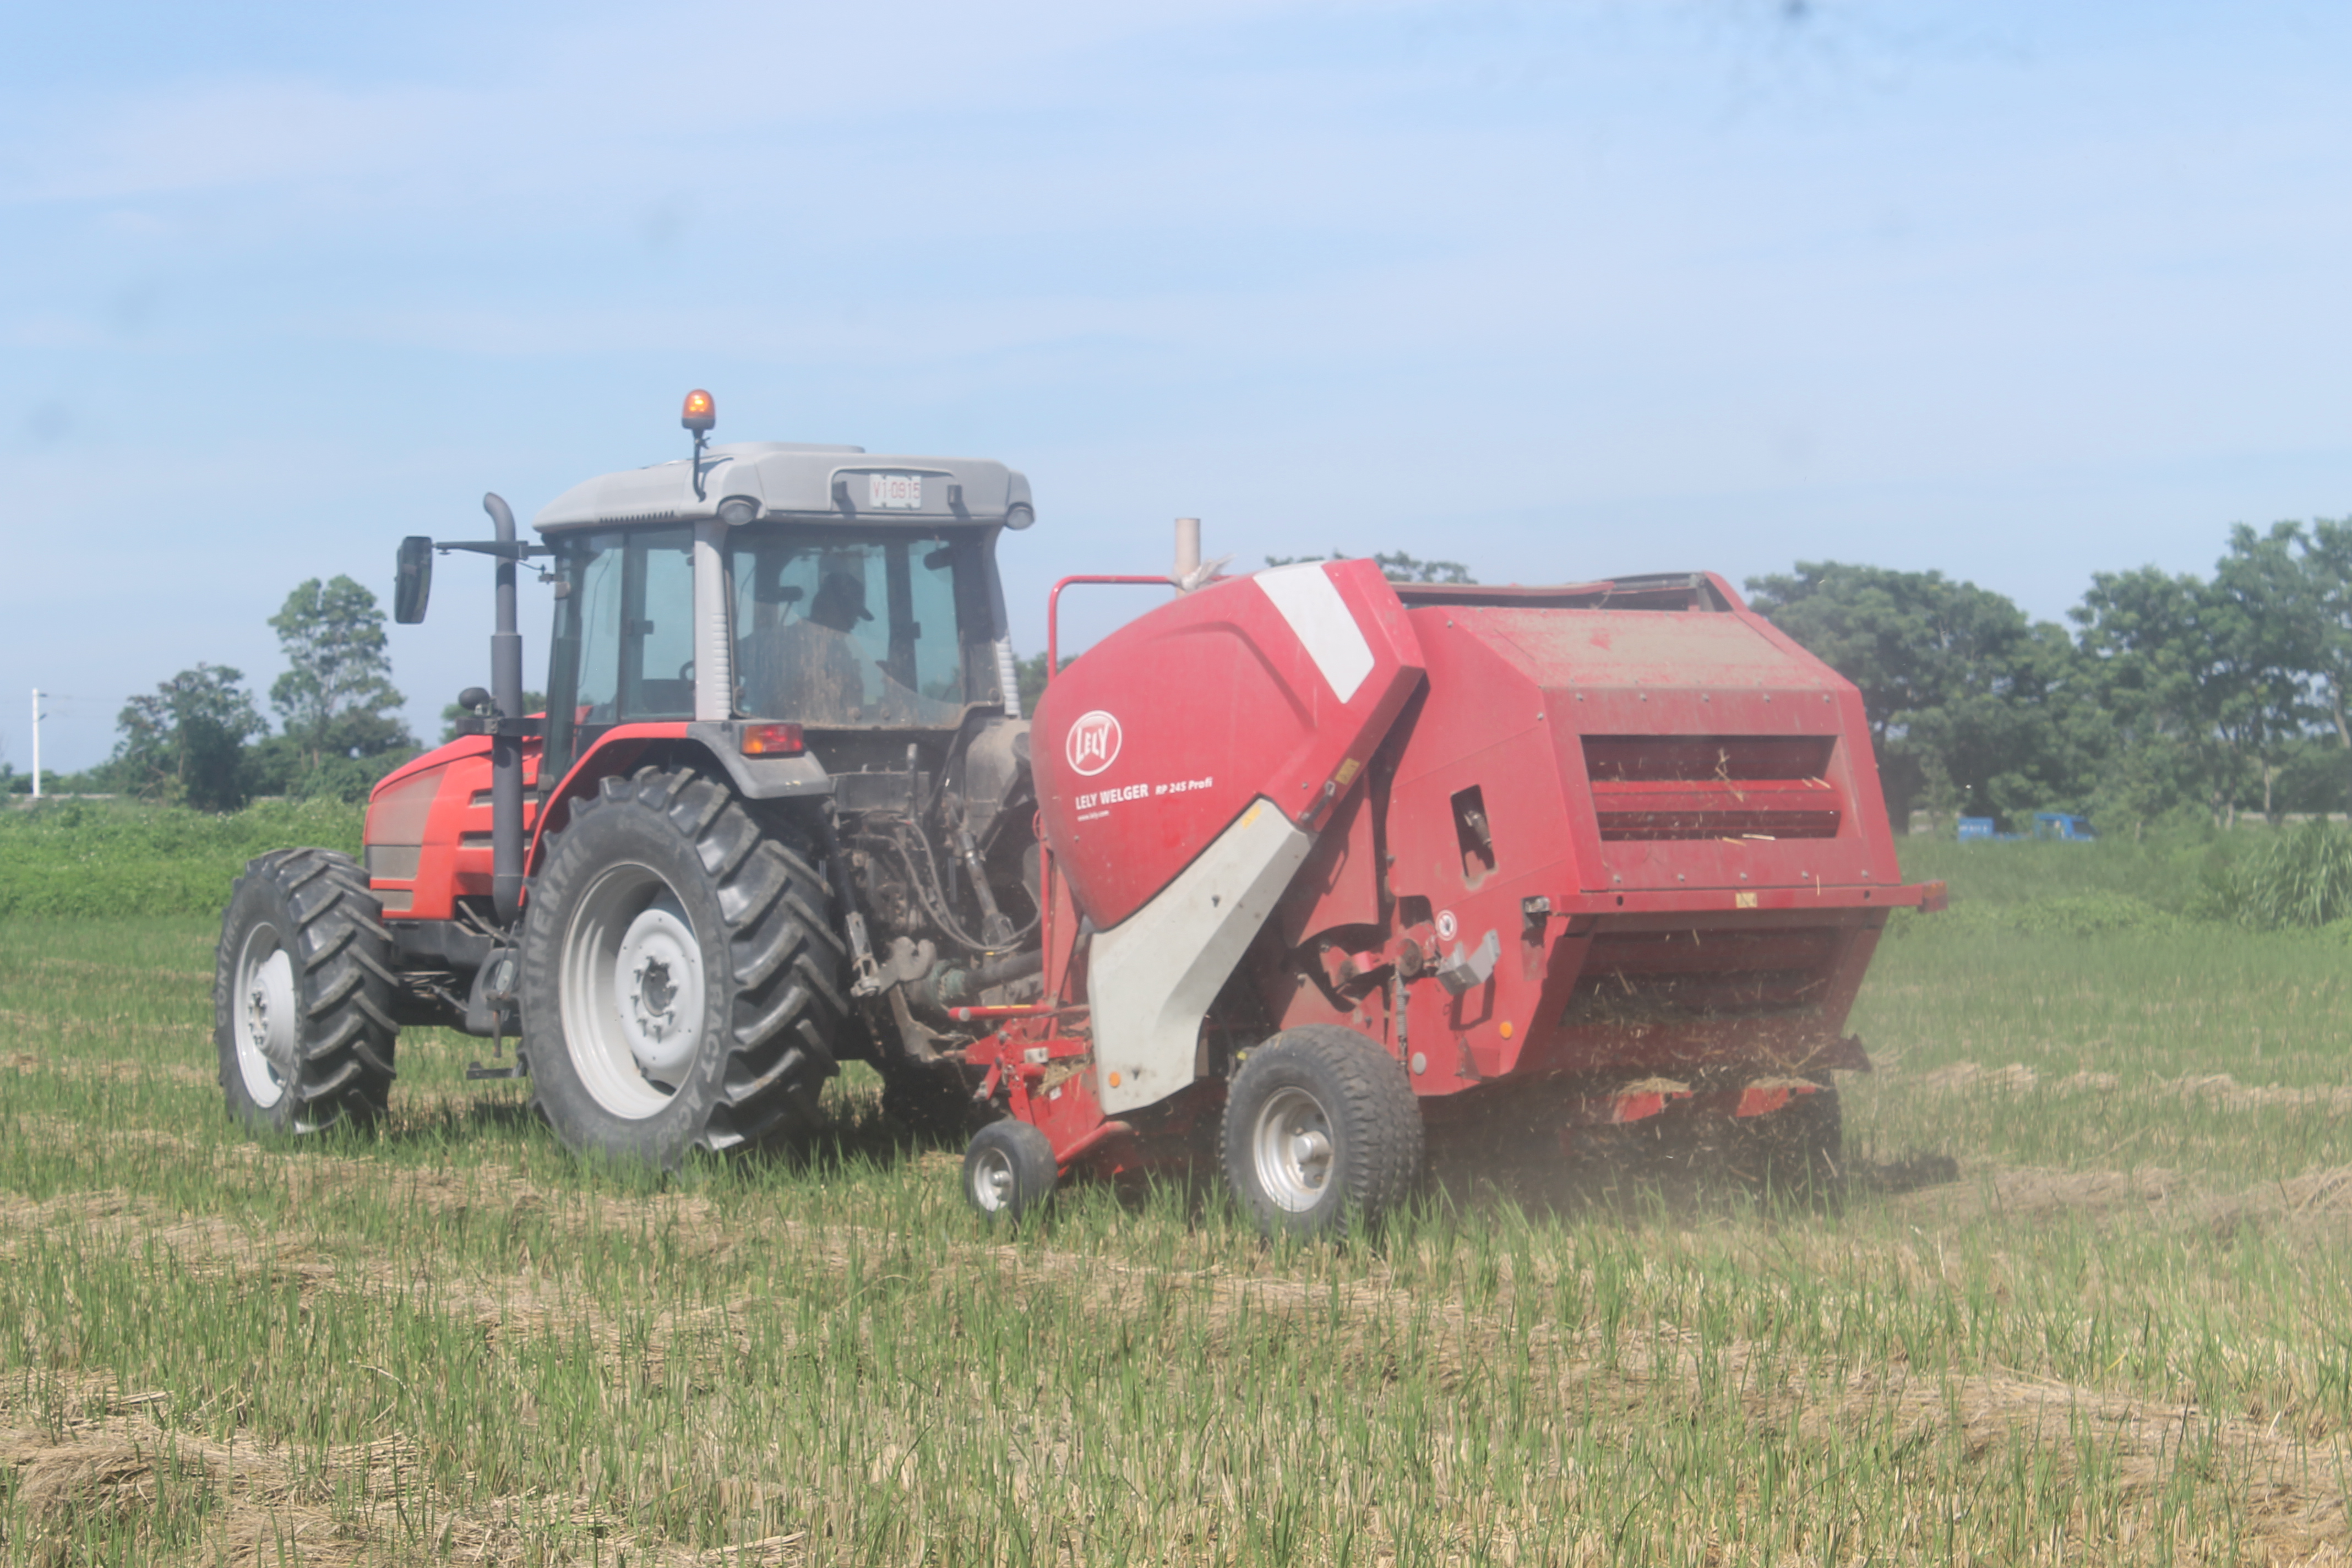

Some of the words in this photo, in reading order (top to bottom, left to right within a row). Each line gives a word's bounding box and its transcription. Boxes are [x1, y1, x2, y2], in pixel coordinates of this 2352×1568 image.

[1076, 722, 1110, 764] LELY
[1076, 793, 1097, 810] LELY
[1100, 783, 1150, 804] WELGER
[1156, 785, 1167, 794] RP
[1189, 777, 1212, 790] Profi
